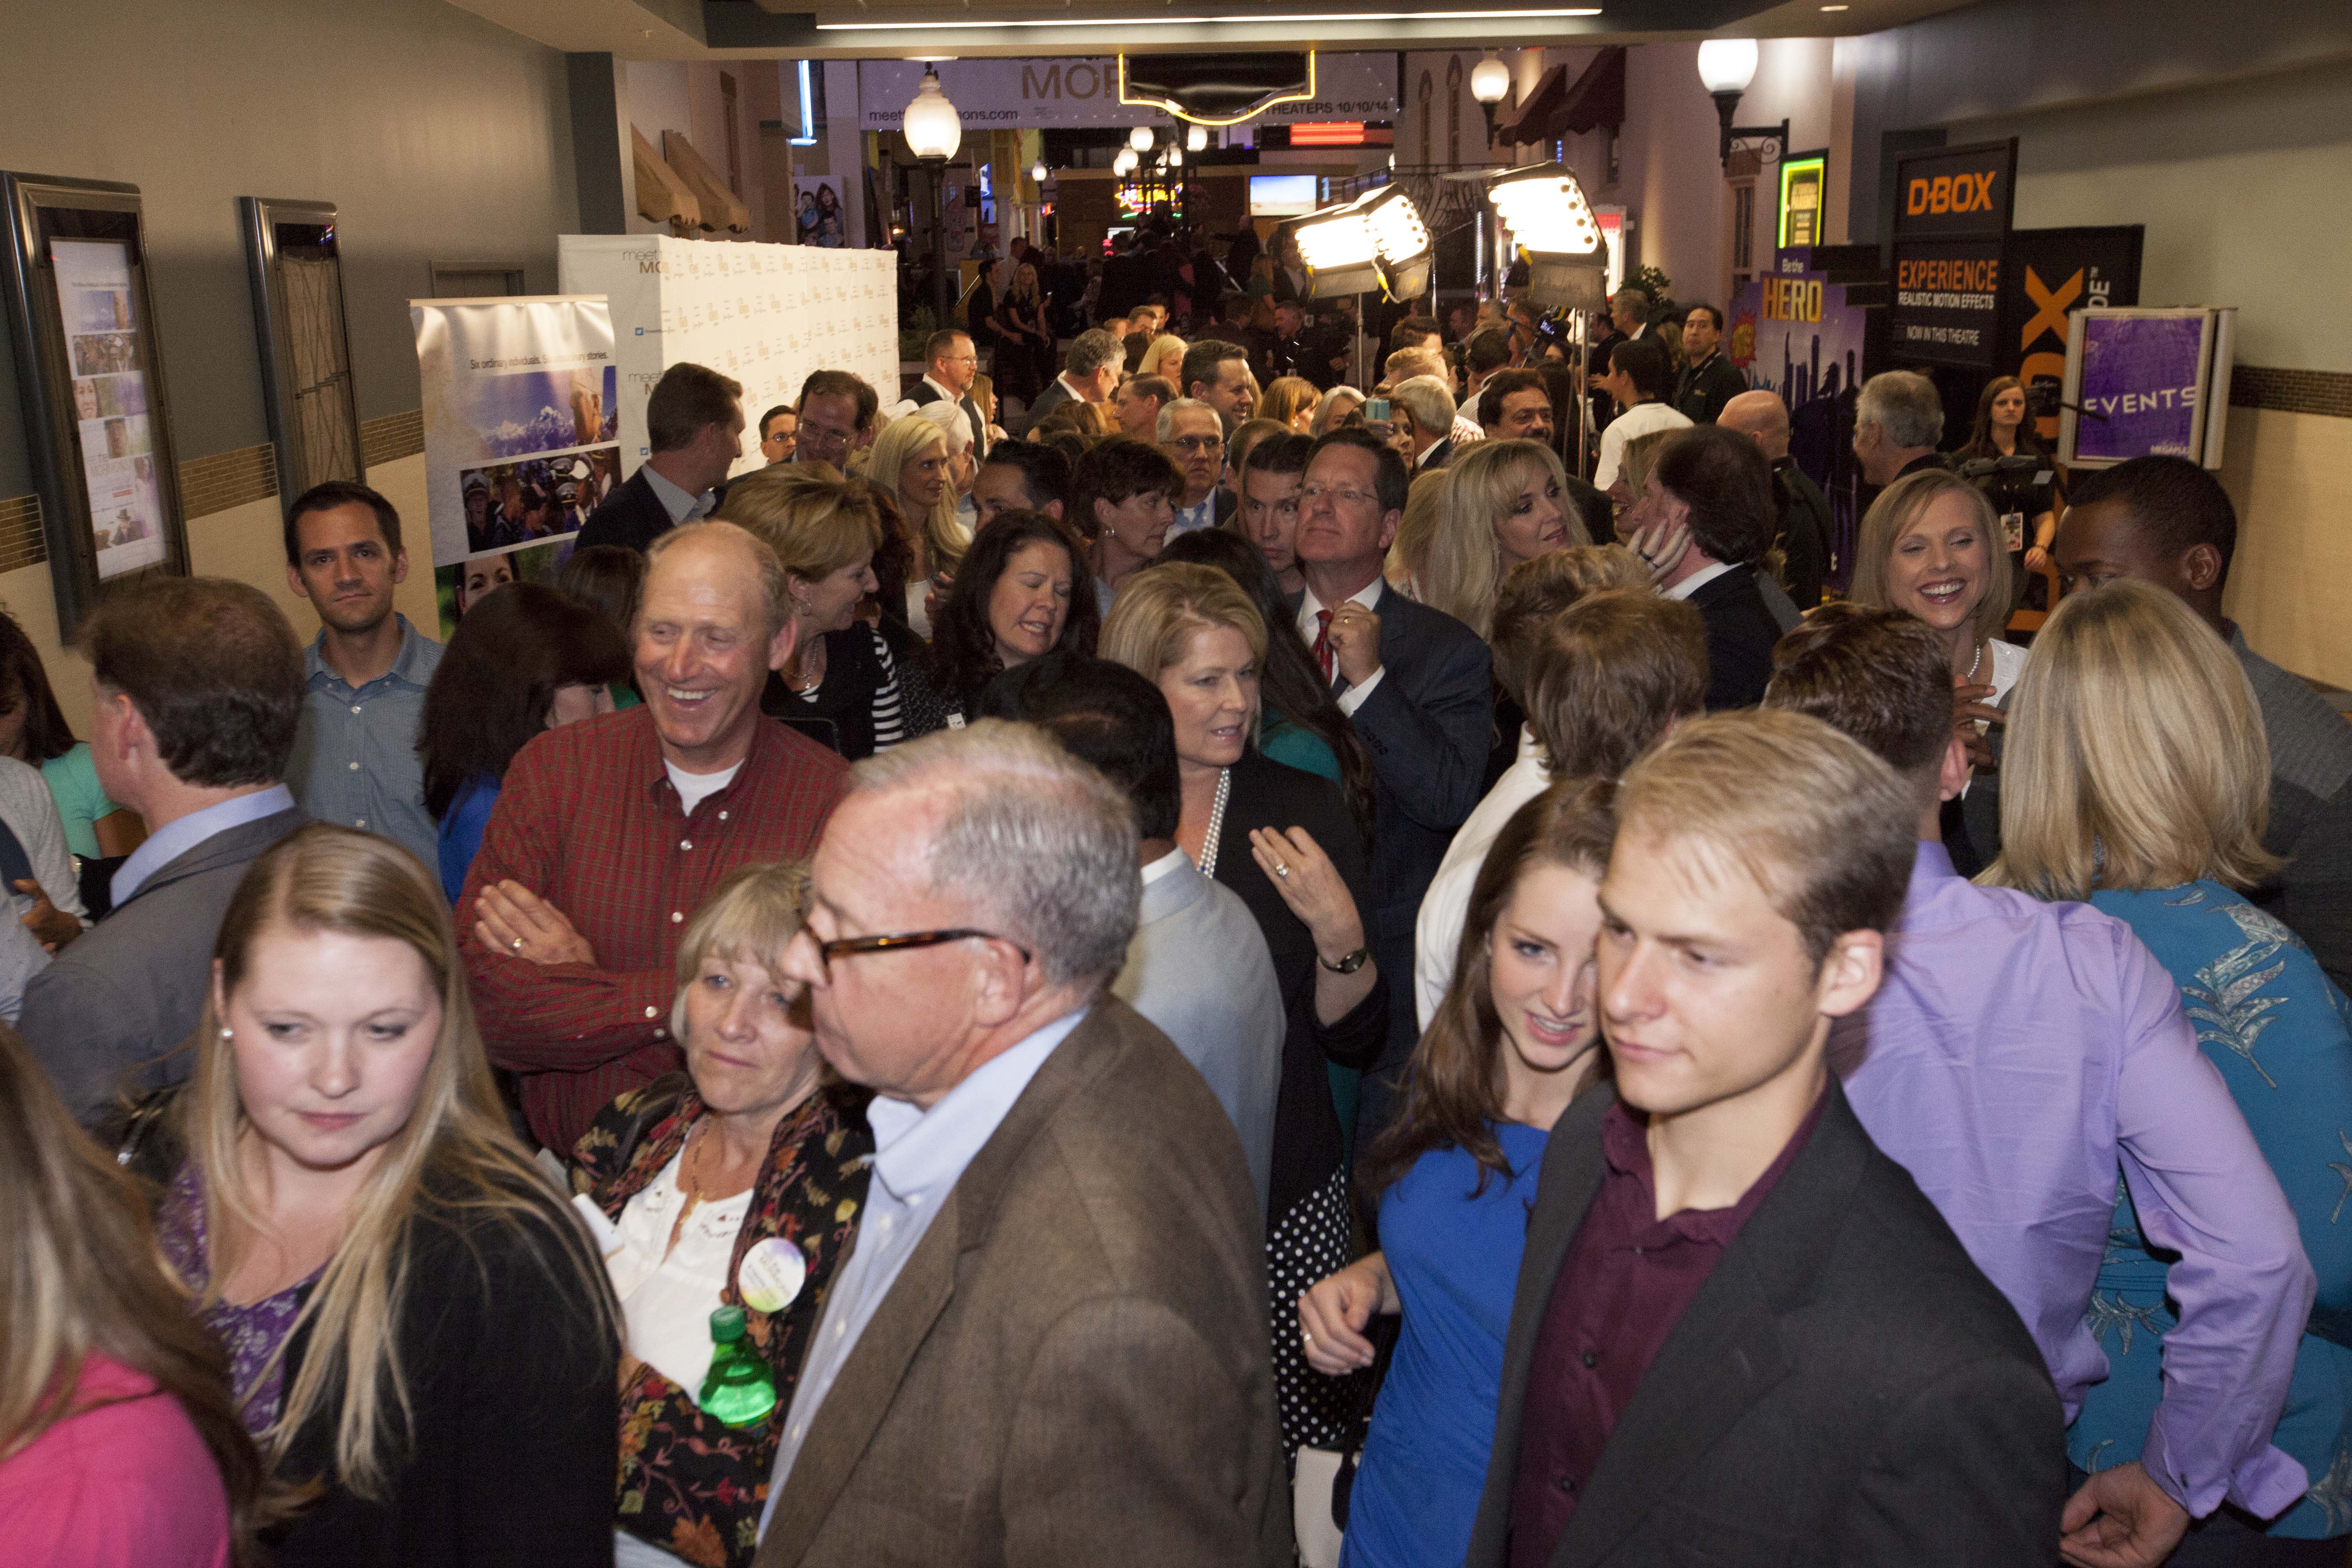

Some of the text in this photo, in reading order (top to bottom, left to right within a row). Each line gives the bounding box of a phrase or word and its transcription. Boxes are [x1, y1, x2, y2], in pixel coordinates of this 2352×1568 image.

[1338, 101, 1388, 113] 10/10/14
[1898, 260, 1999, 291] EXPERIENCE
[1762, 277, 1823, 322] HERO
[1898, 291, 1995, 310] REALISTIC MOTION EFFECTS
[1906, 325, 1981, 346] NOW IN THIS THEATRE
[2084, 386, 2198, 414] EVENTS
